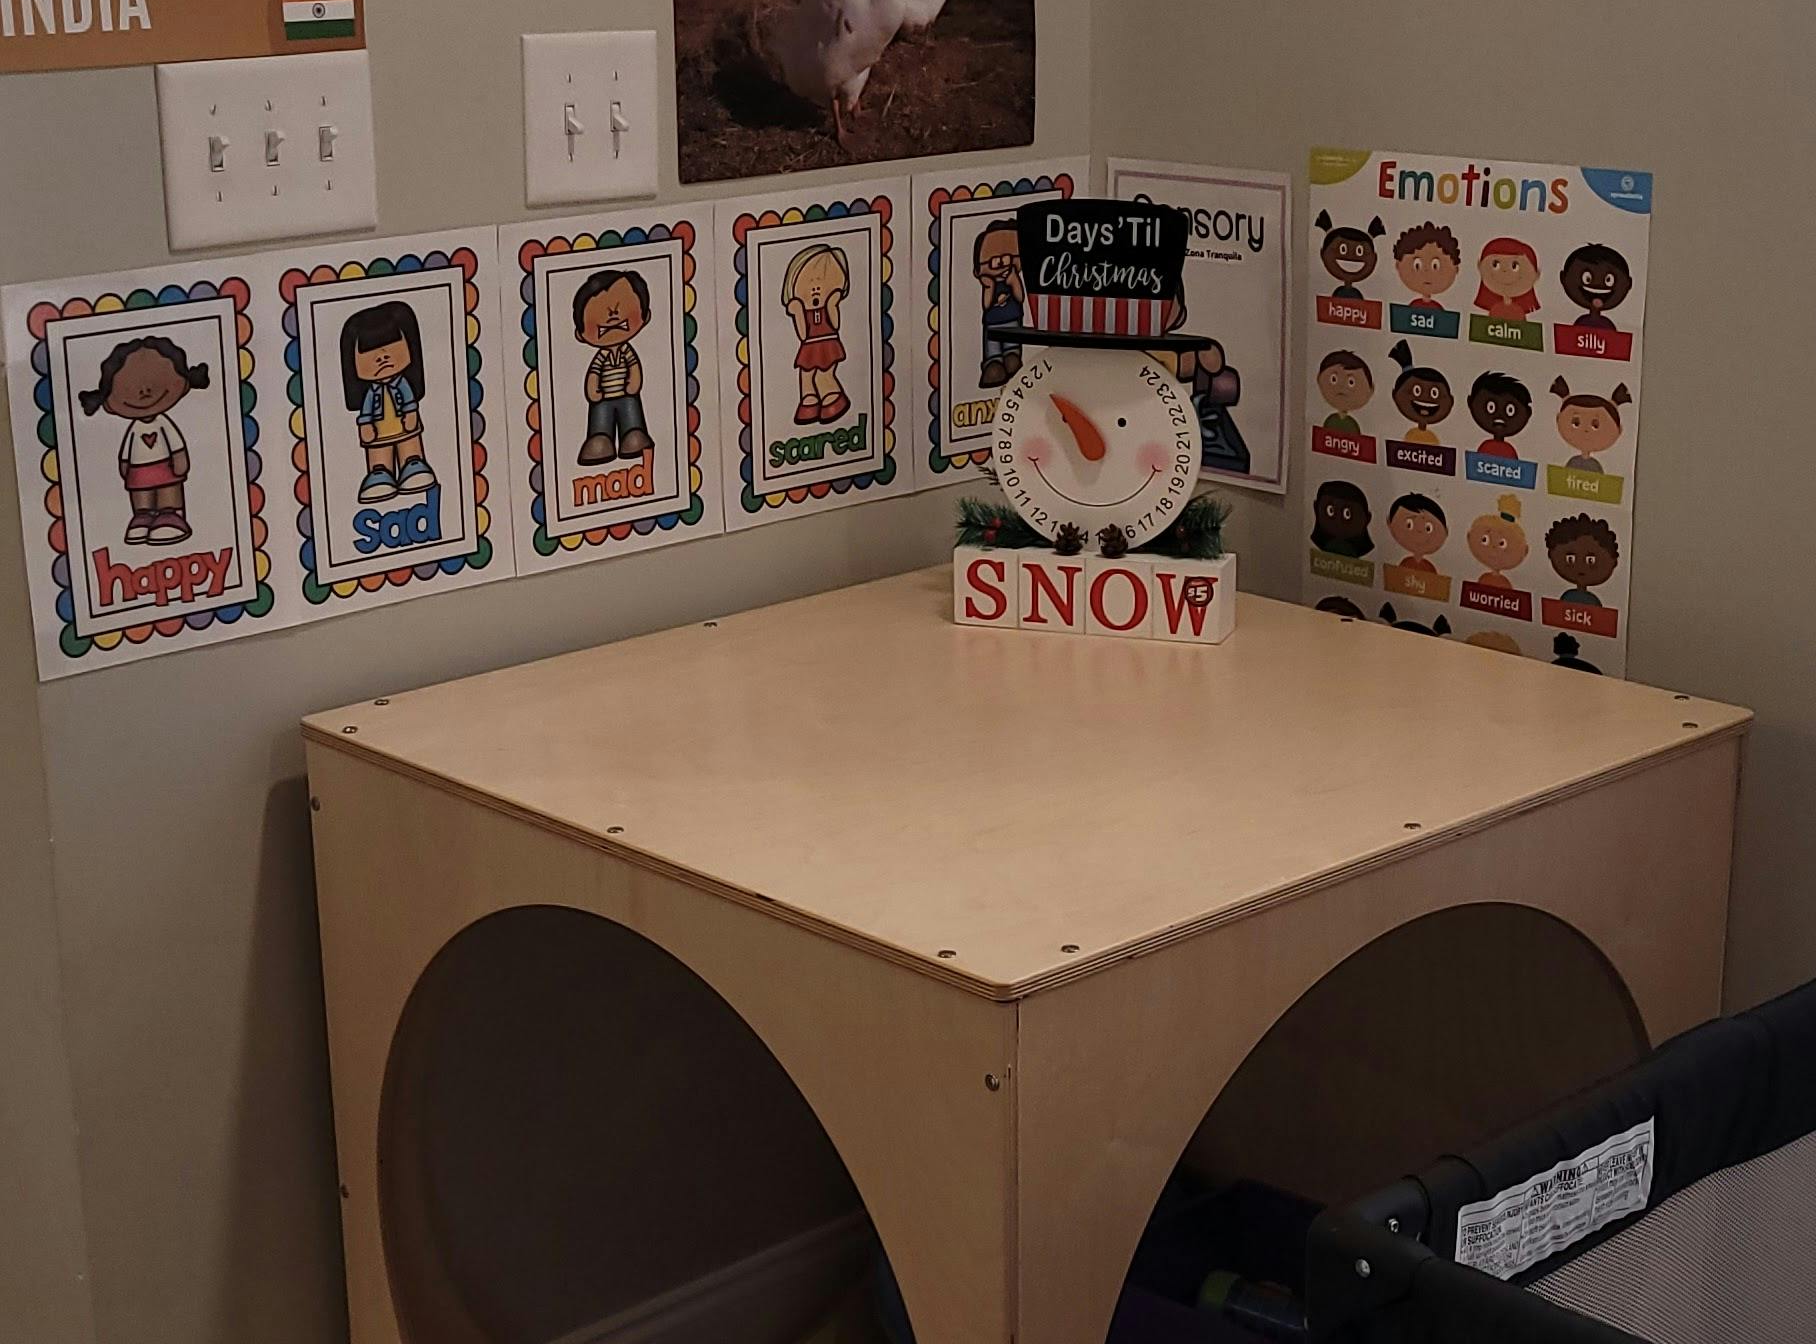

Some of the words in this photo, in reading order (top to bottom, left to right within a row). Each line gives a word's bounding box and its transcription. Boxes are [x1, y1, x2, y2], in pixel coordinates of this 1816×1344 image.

[1378, 160, 1569, 214] Emotions
[1046, 214, 1114, 252] Days
[1134, 193, 1265, 253] nsory
[1039, 251, 1164, 294] Christmas
[1329, 302, 1368, 325] happy
[1410, 313, 1435, 330] sad
[1487, 324, 1523, 341] calm
[1577, 333, 1606, 354] silly
[1030, 365, 1043, 380] 2
[1043, 359, 1053, 373] 1
[1138, 365, 1162, 387] 24
[1021, 375, 1034, 389] 3
[1012, 388, 1025, 400] 4
[1156, 383, 1177, 405] 23
[1006, 398, 1020, 412] 5
[1001, 412, 1015, 424] 6
[1168, 404, 1188, 427] 22
[769, 413, 868, 469] scared
[999, 426, 1013, 438] 7
[1175, 431, 1191, 451] 21
[998, 440, 1012, 450] 8
[1324, 436, 1361, 457] angry
[999, 454, 1013, 464] 9
[1175, 455, 1190, 476] 20
[1397, 449, 1444, 468] excited
[572, 447, 654, 508] mad
[1003, 468, 1021, 487] 10
[1477, 460, 1522, 481] scared
[1168, 476, 1185, 496] 19
[1566, 474, 1601, 493] tired
[1014, 489, 1032, 507] 11
[1155, 497, 1174, 517] 18
[352, 483, 443, 554] sad
[1031, 506, 1049, 526] 12
[1137, 512, 1155, 532] 17
[92, 546, 234, 608] happy
[1313, 558, 1370, 579] confused
[1403, 576, 1426, 594] shy
[965, 559, 1219, 637] SNOW
[1469, 590, 1521, 613] worried
[1564, 607, 1593, 627] sick
[1540, 1165, 1582, 1196] WANING
